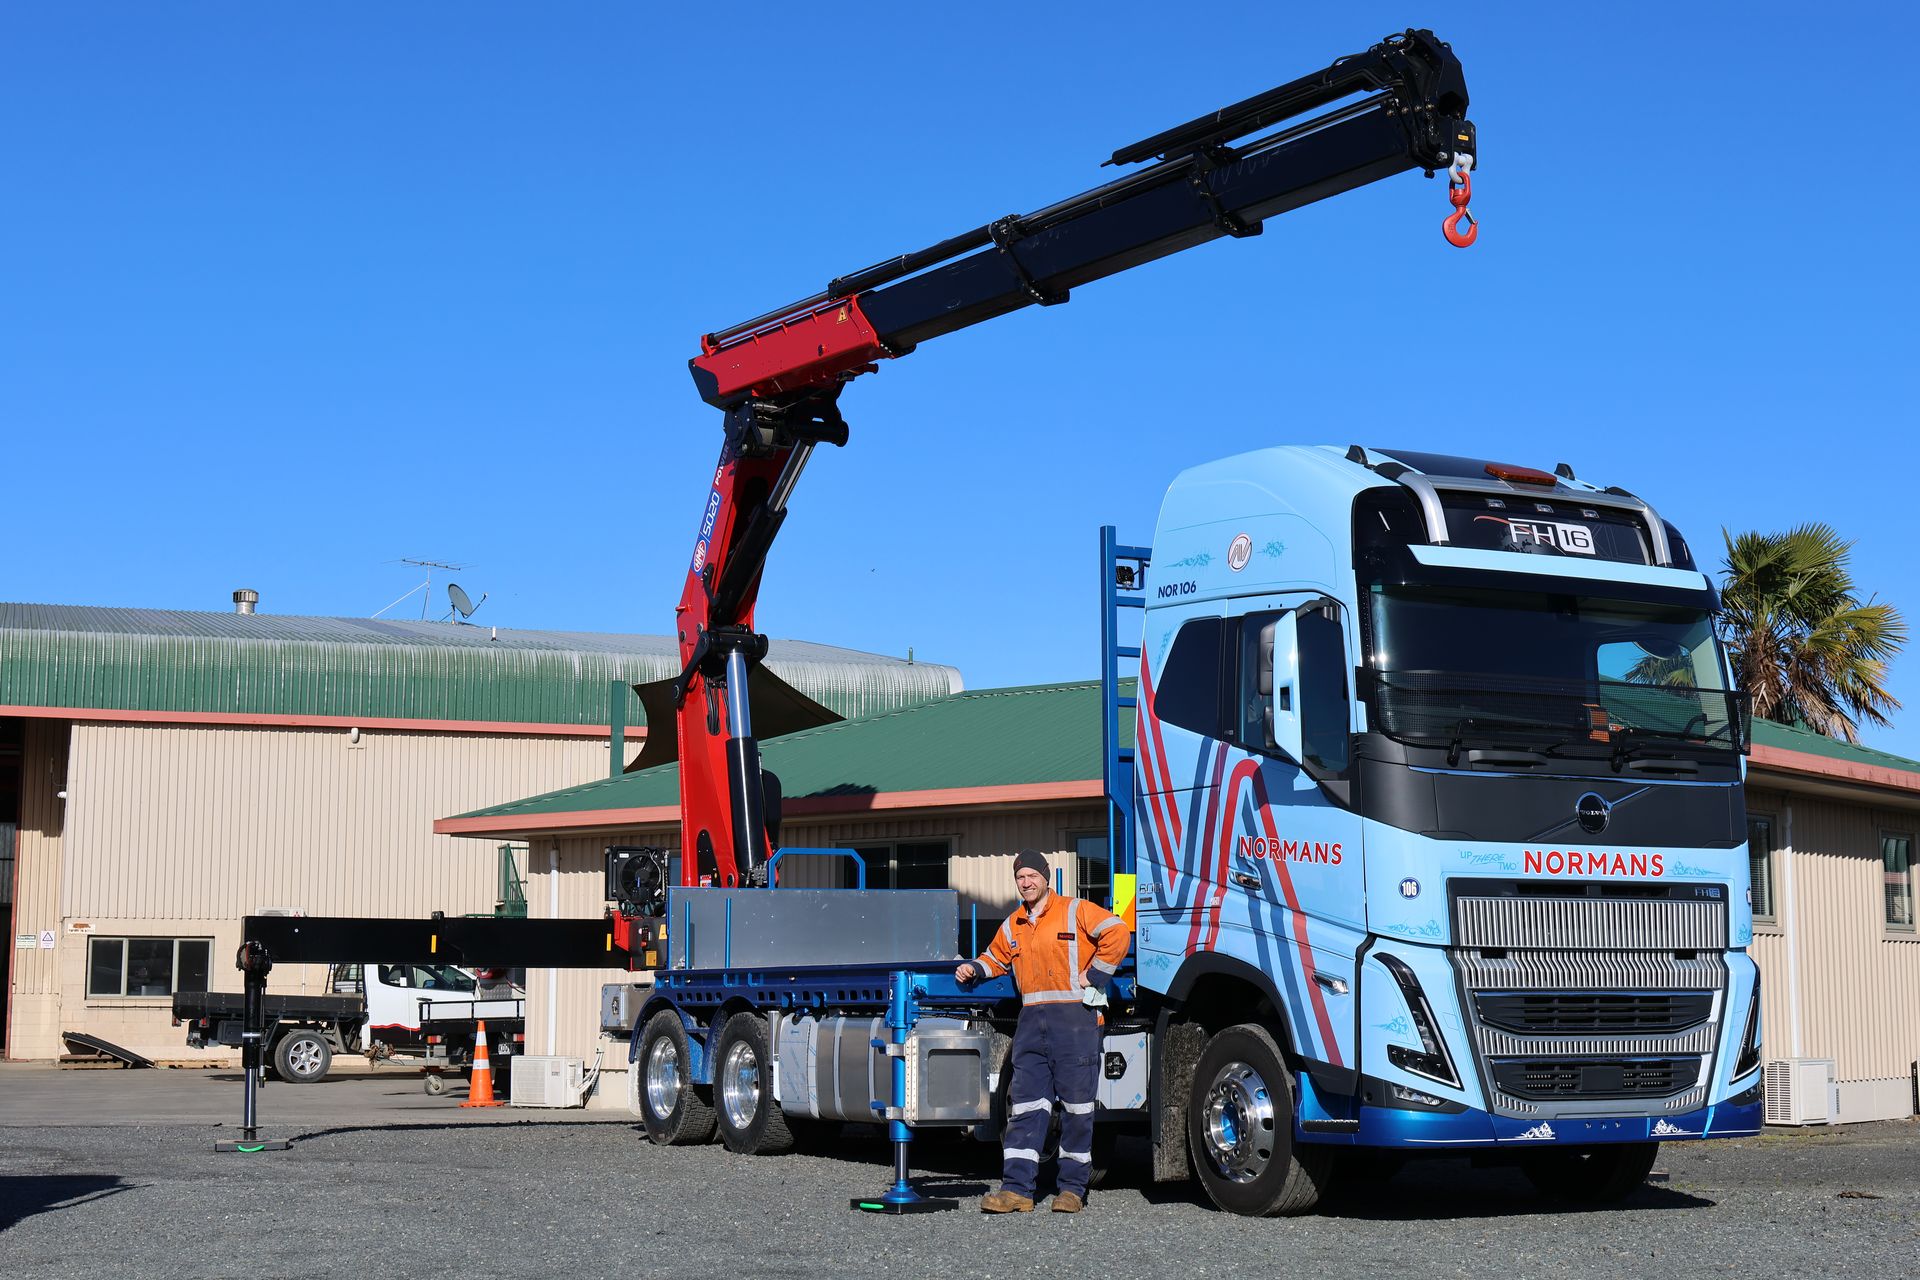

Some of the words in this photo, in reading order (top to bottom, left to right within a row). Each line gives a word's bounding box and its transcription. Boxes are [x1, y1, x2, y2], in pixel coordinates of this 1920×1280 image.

[694, 541, 706, 570] HMF
[703, 492, 720, 537] 5020
[1158, 584, 1178, 598] NOR
[1180, 581, 1196, 595] 106
[1240, 836, 1342, 865] NORMANS
[1524, 850, 1664, 877] NORMANS
[1401, 881, 1417, 896] 106
